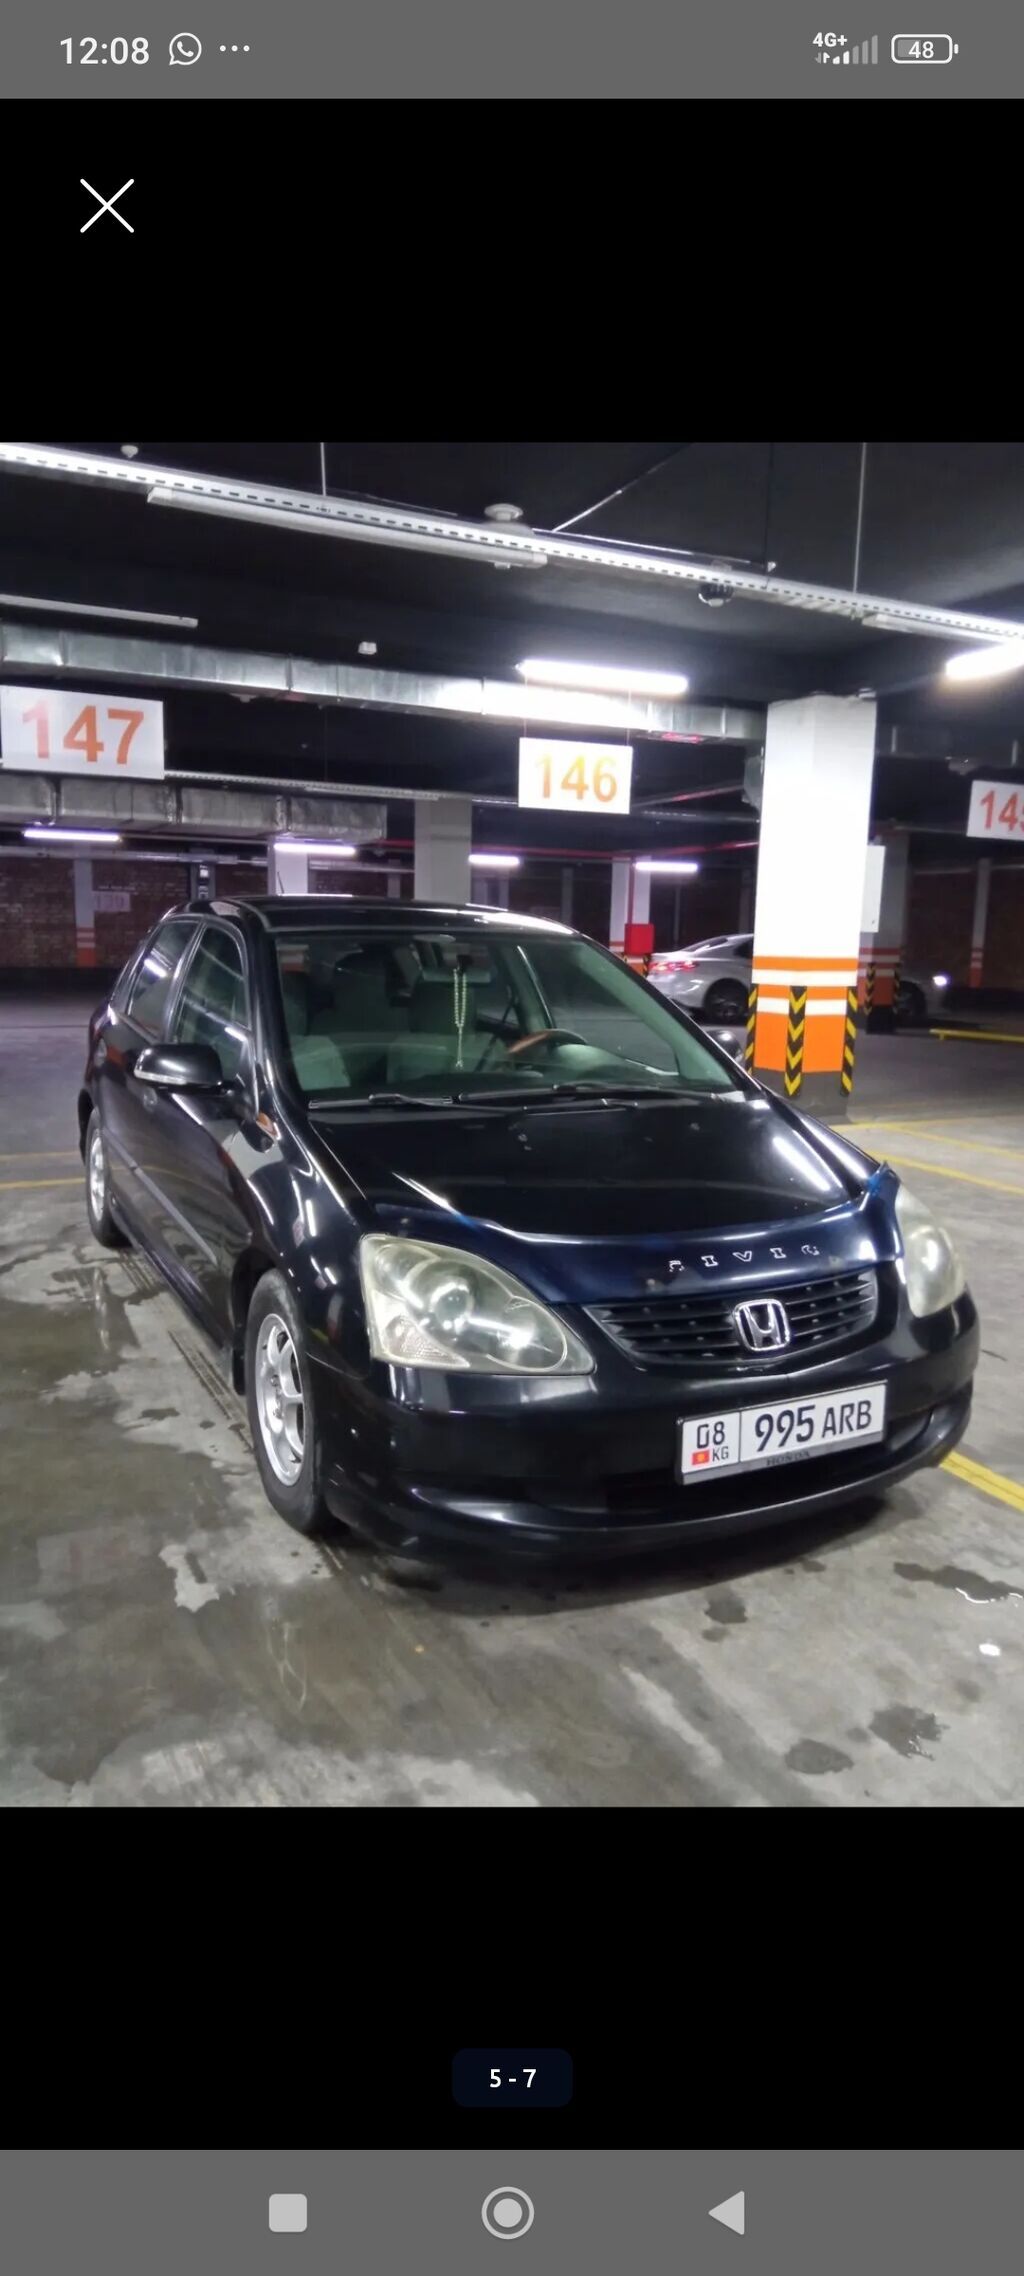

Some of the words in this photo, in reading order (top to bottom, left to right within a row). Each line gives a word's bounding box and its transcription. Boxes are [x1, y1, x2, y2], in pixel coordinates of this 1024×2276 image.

[22, 700, 145, 765] 147
[535, 753, 618, 803] 146
[980, 790, 1024, 831] 14
[696, 1420, 726, 1450] 08
[754, 1404, 816, 1453] 995
[821, 1399, 872, 1439] ARB
[712, 1445, 730, 1462] KG
[766, 1450, 811, 1467] HONDA
